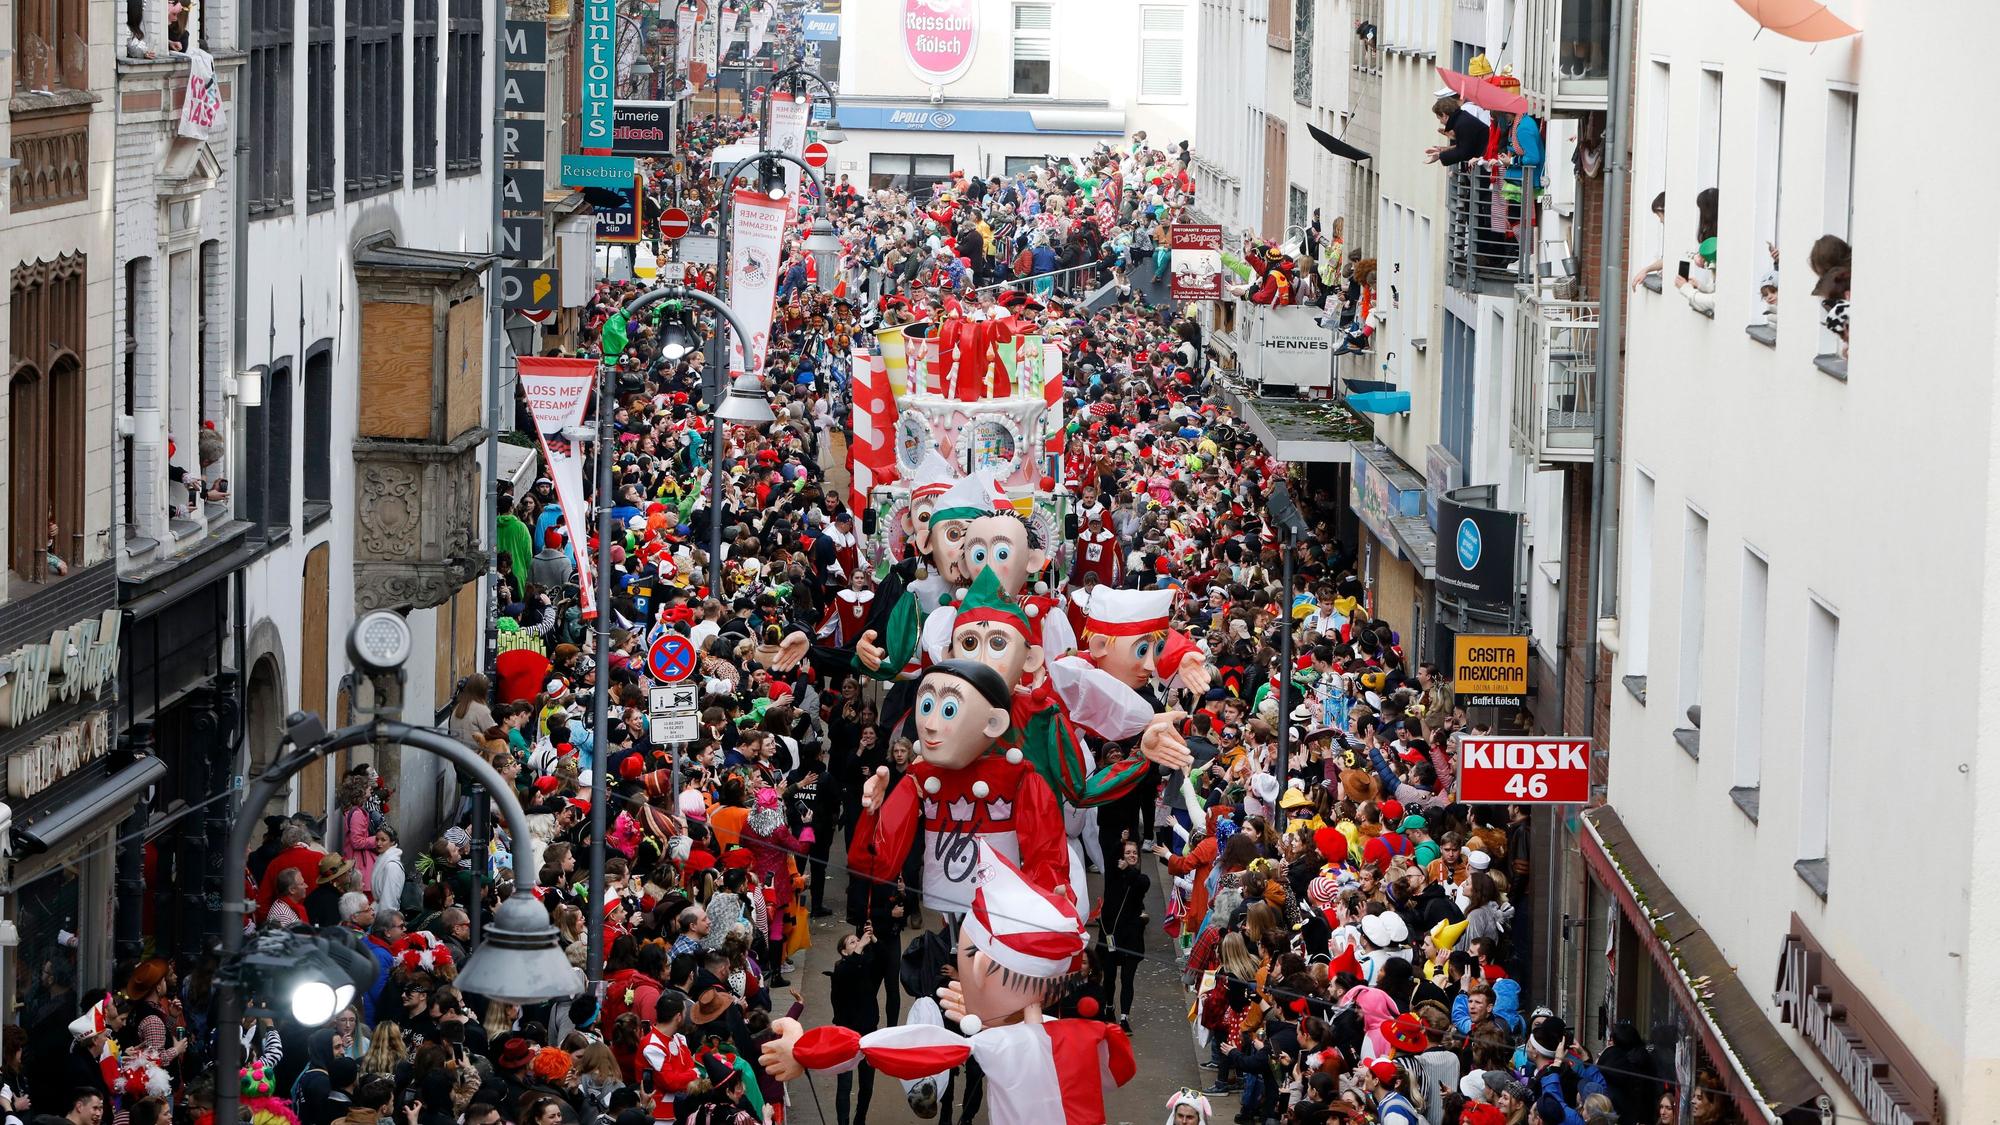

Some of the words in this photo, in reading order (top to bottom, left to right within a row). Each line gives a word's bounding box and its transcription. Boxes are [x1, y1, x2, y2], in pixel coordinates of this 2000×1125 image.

[807, 20, 836, 31] APOLLO
[915, 34, 961, 55] Kölsch
[890, 110, 929, 123] APOLLO
[563, 164, 632, 179] Reisebüro
[595, 213, 632, 225] ALDI
[1265, 340, 1329, 350] HENNES
[527, 385, 556, 396] LOSS
[637, 597, 646, 606] P
[1468, 647, 1515, 663] CASITA
[1459, 665, 1524, 681] MEXICANA
[1472, 695, 1494, 706] Gaffel
[1495, 696, 1520, 706] Kölsch
[1464, 743, 1588, 770] KIOSK
[1504, 773, 1548, 798] 46
[794, 792, 817, 800] SWAT
